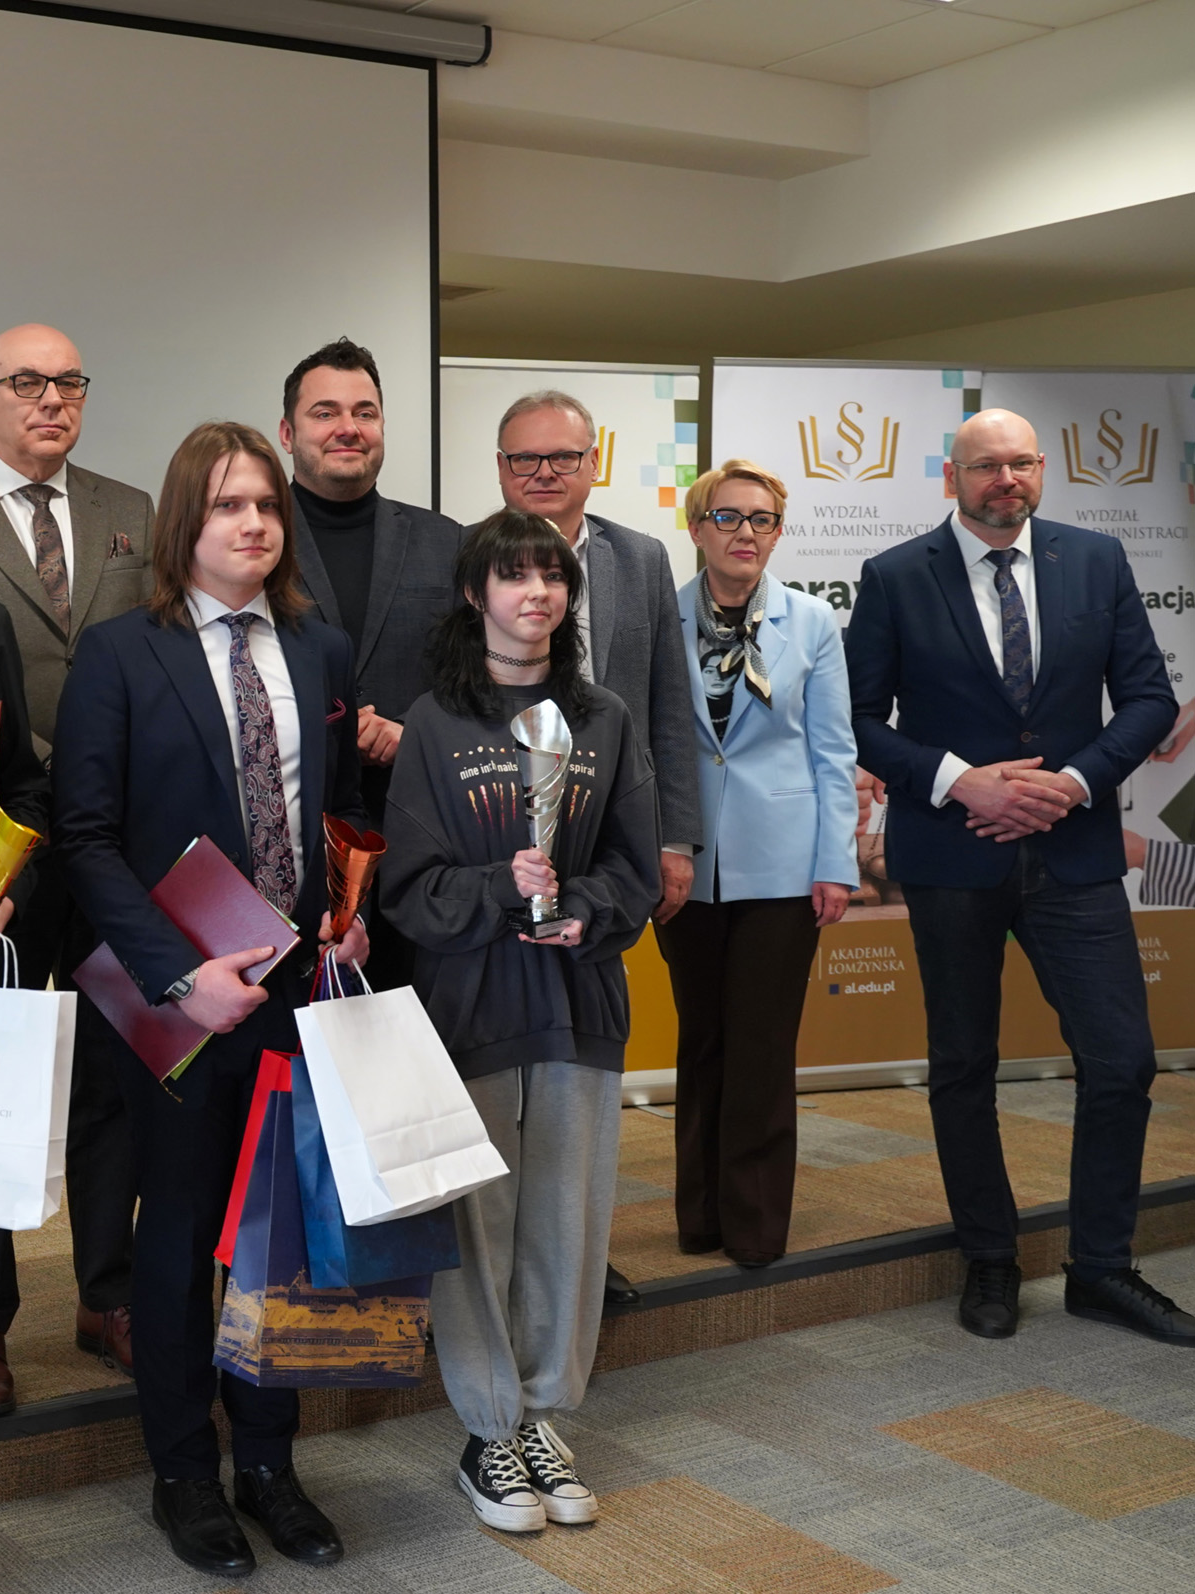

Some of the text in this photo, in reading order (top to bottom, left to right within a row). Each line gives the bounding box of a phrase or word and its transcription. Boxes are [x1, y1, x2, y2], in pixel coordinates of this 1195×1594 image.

[813, 505, 880, 519] WYDZIAŁ
[1075, 509, 1141, 522] WYDZIAŁ
[459, 766, 480, 780] nine
[496, 761, 519, 773] nails
[569, 763, 595, 777] spiral
[830, 946, 896, 960] AKADEMIA
[828, 958, 905, 975] ŁOMŻYŃSKA
[844, 980, 896, 995] al.edu.pl
